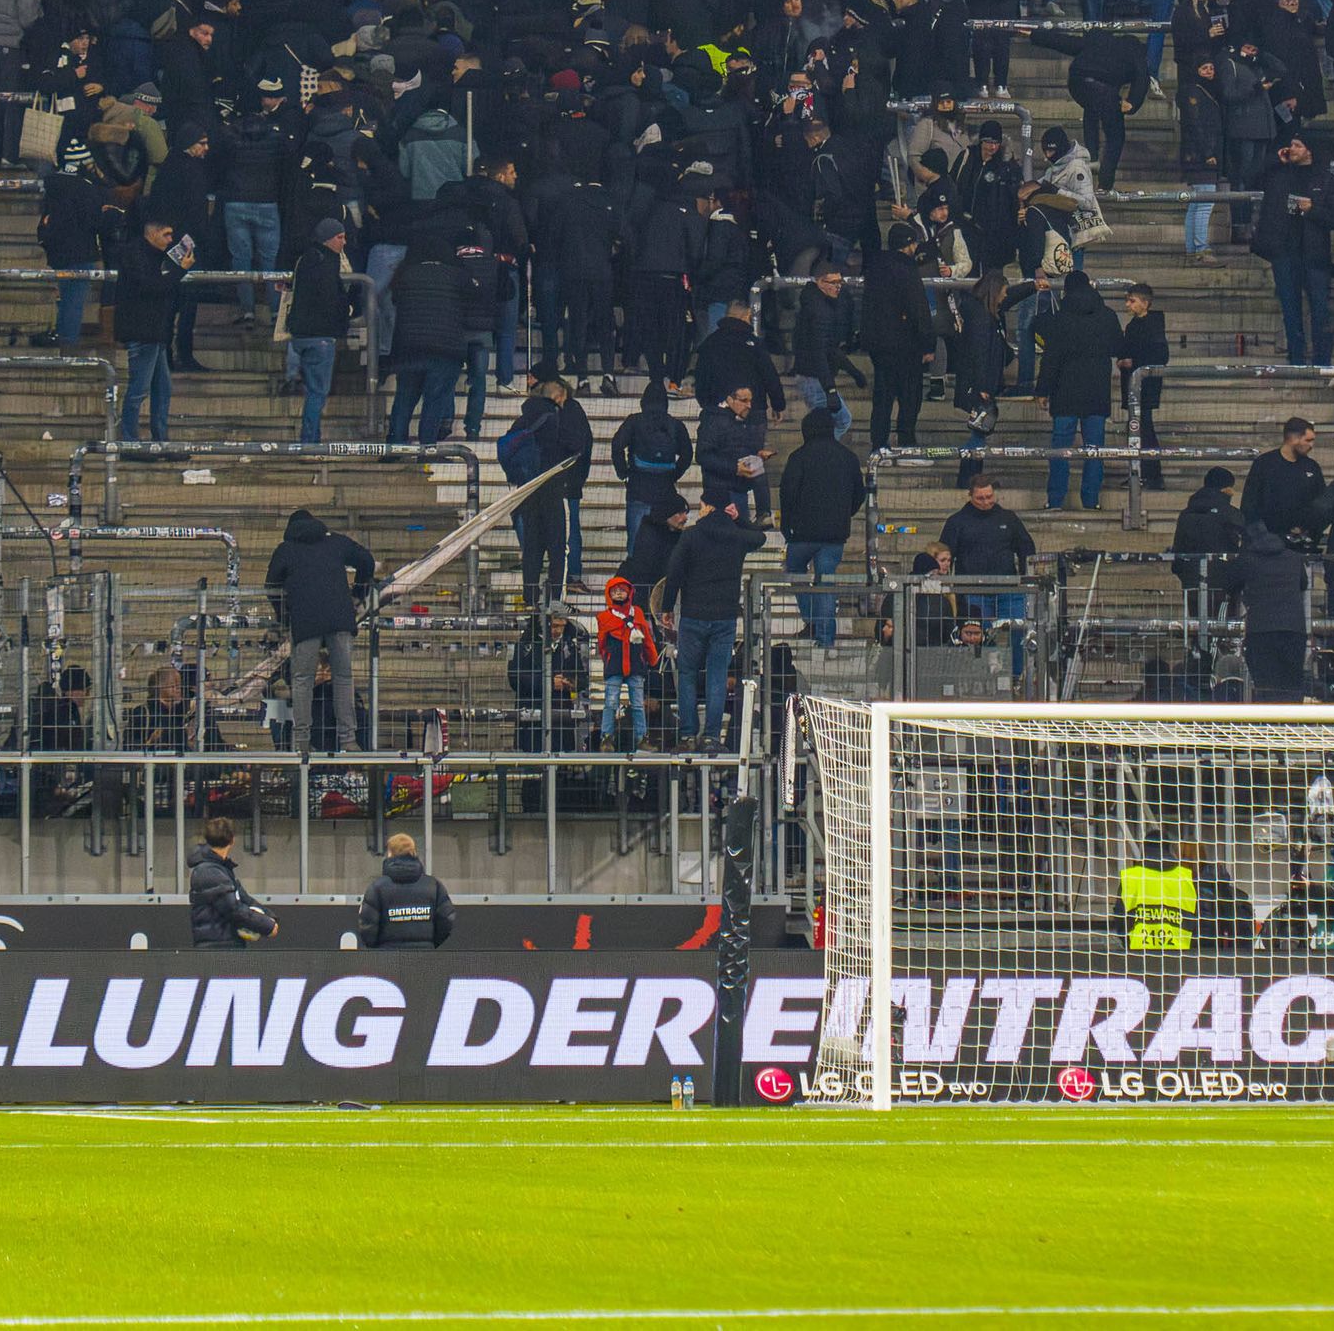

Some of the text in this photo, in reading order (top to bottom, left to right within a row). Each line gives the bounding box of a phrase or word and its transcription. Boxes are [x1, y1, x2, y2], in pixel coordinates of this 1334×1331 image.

[388, 906, 431, 917] EINTRACHT
[1141, 929, 1176, 947] 2192
[427, 977, 715, 1068] DER
[799, 1071, 844, 1097] LG
[949, 1081, 987, 1096] evo
[1100, 1071, 1287, 1097] LG OLED evo
